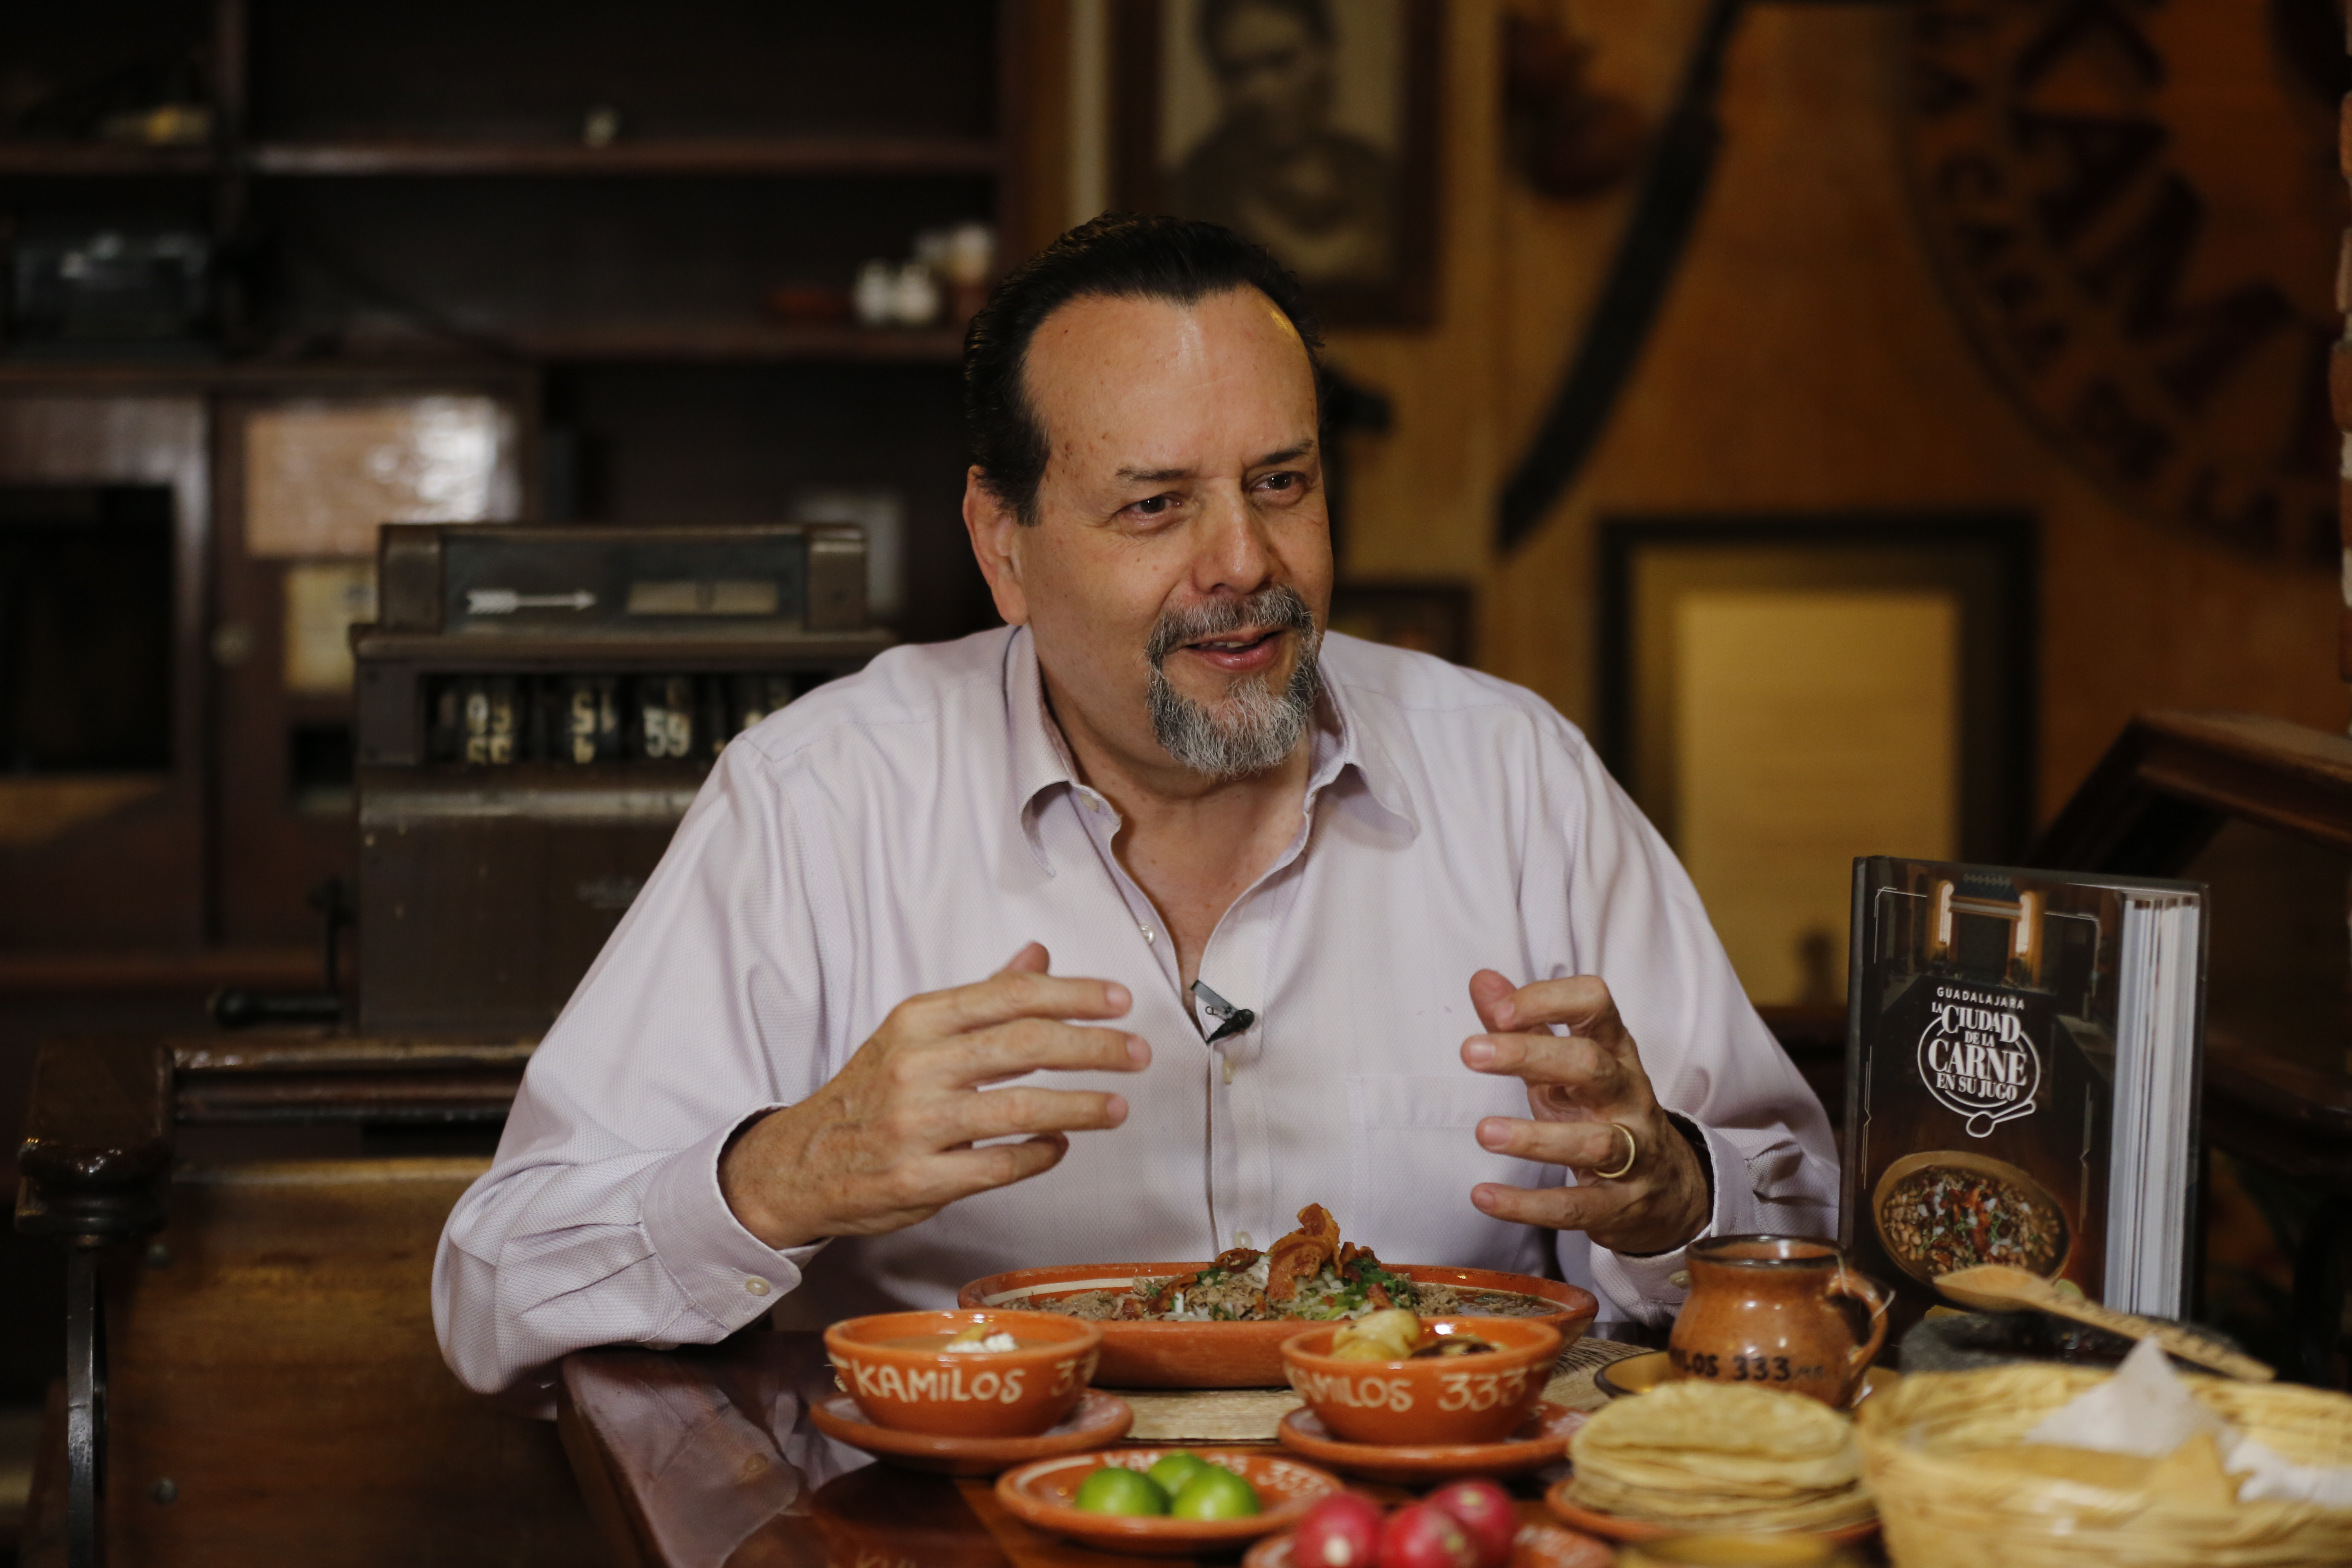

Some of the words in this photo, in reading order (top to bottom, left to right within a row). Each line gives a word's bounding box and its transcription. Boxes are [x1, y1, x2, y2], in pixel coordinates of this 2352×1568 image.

[1937, 987, 2025, 1010] GUADALAJARA
[1932, 1002, 1942, 1013] LA
[1942, 1004, 2021, 1042] CIUDAD
[1964, 1031, 1980, 1044] DE
[1982, 1033, 1995, 1047] LA
[1928, 1038, 2027, 1086] CARNE
[1936, 1072, 1956, 1090] EN
[1958, 1076, 1977, 1094] SU
[1978, 1080, 2018, 1101] JUGO
[851, 1358, 1026, 1404] KAMILOS
[1732, 1355, 1791, 1382] 333
[1437, 1367, 1528, 1412] 333
